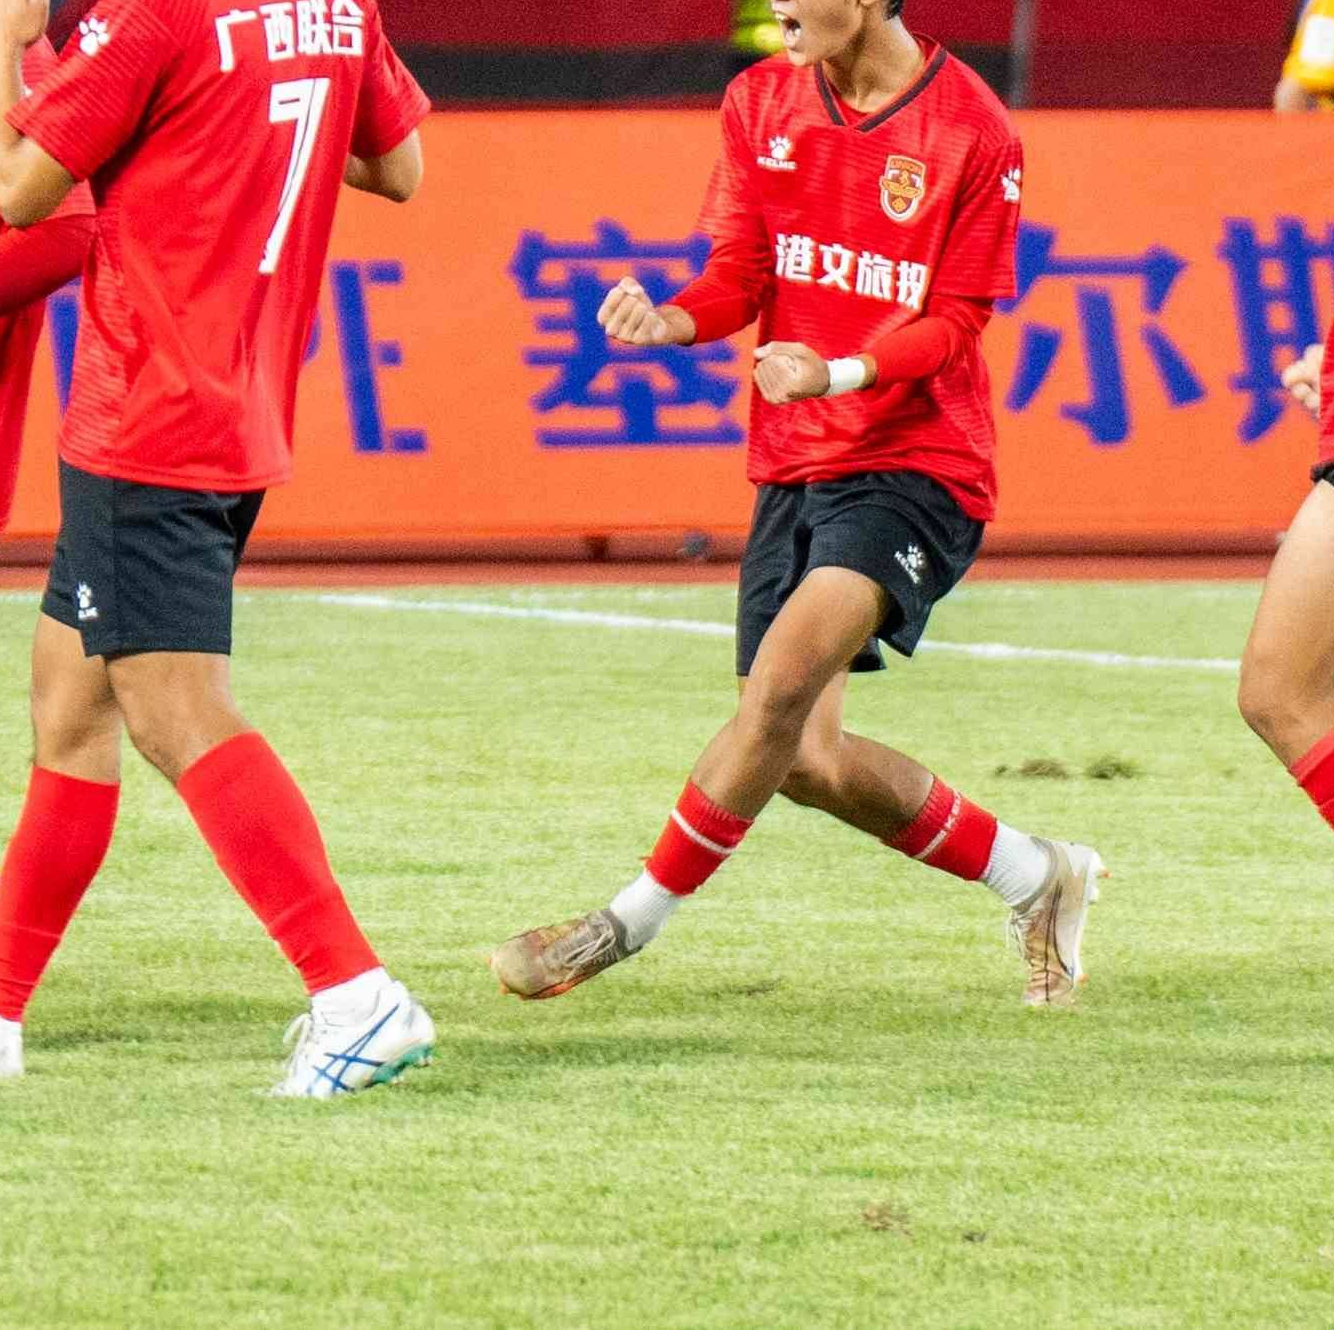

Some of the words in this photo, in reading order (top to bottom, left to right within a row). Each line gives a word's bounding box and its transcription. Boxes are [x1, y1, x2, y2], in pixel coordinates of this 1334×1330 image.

[258, 77, 331, 275] 7
[756, 155, 797, 170] KELME
[774, 232, 929, 310] 港文旅投
